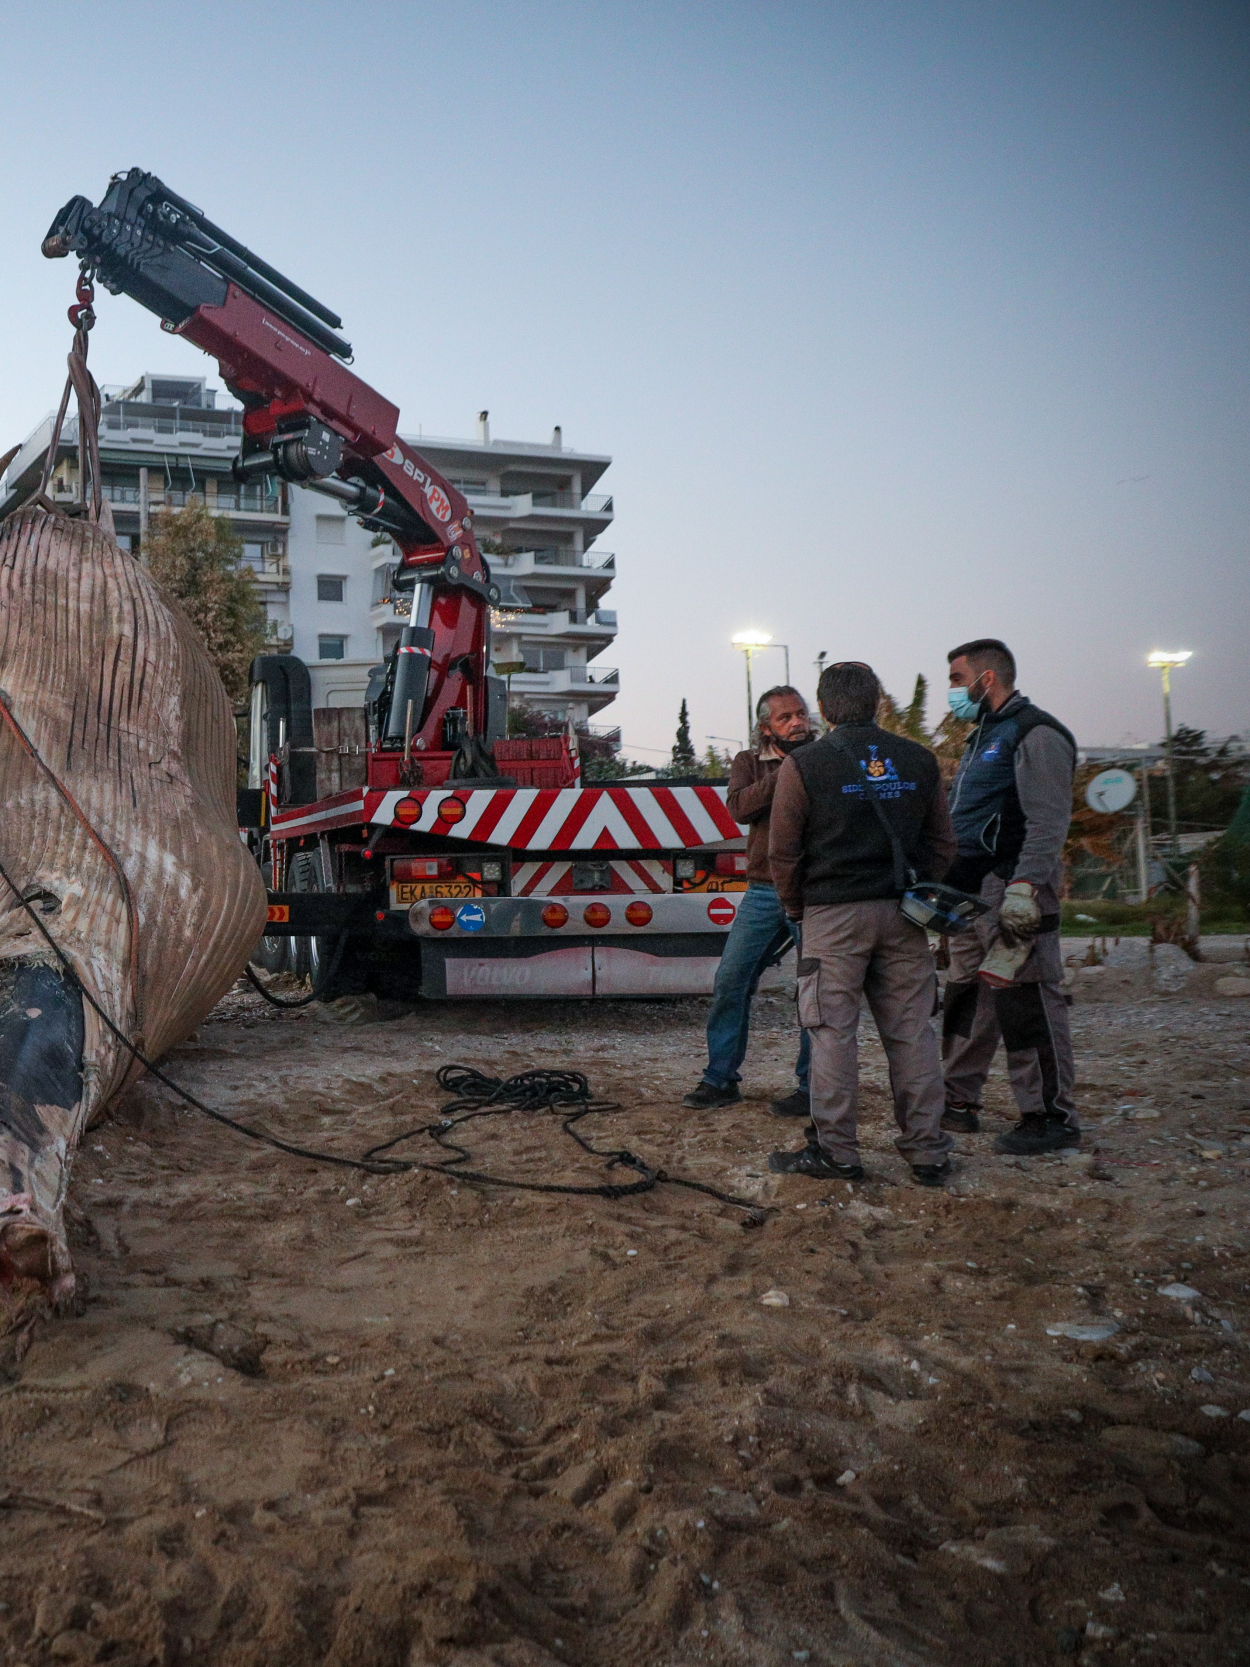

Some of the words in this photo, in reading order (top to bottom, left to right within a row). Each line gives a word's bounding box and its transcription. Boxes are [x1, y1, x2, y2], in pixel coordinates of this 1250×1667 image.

[429, 486, 451, 520] PM
[435, 884, 472, 898] 6322
[463, 965, 531, 986] VOLVO
